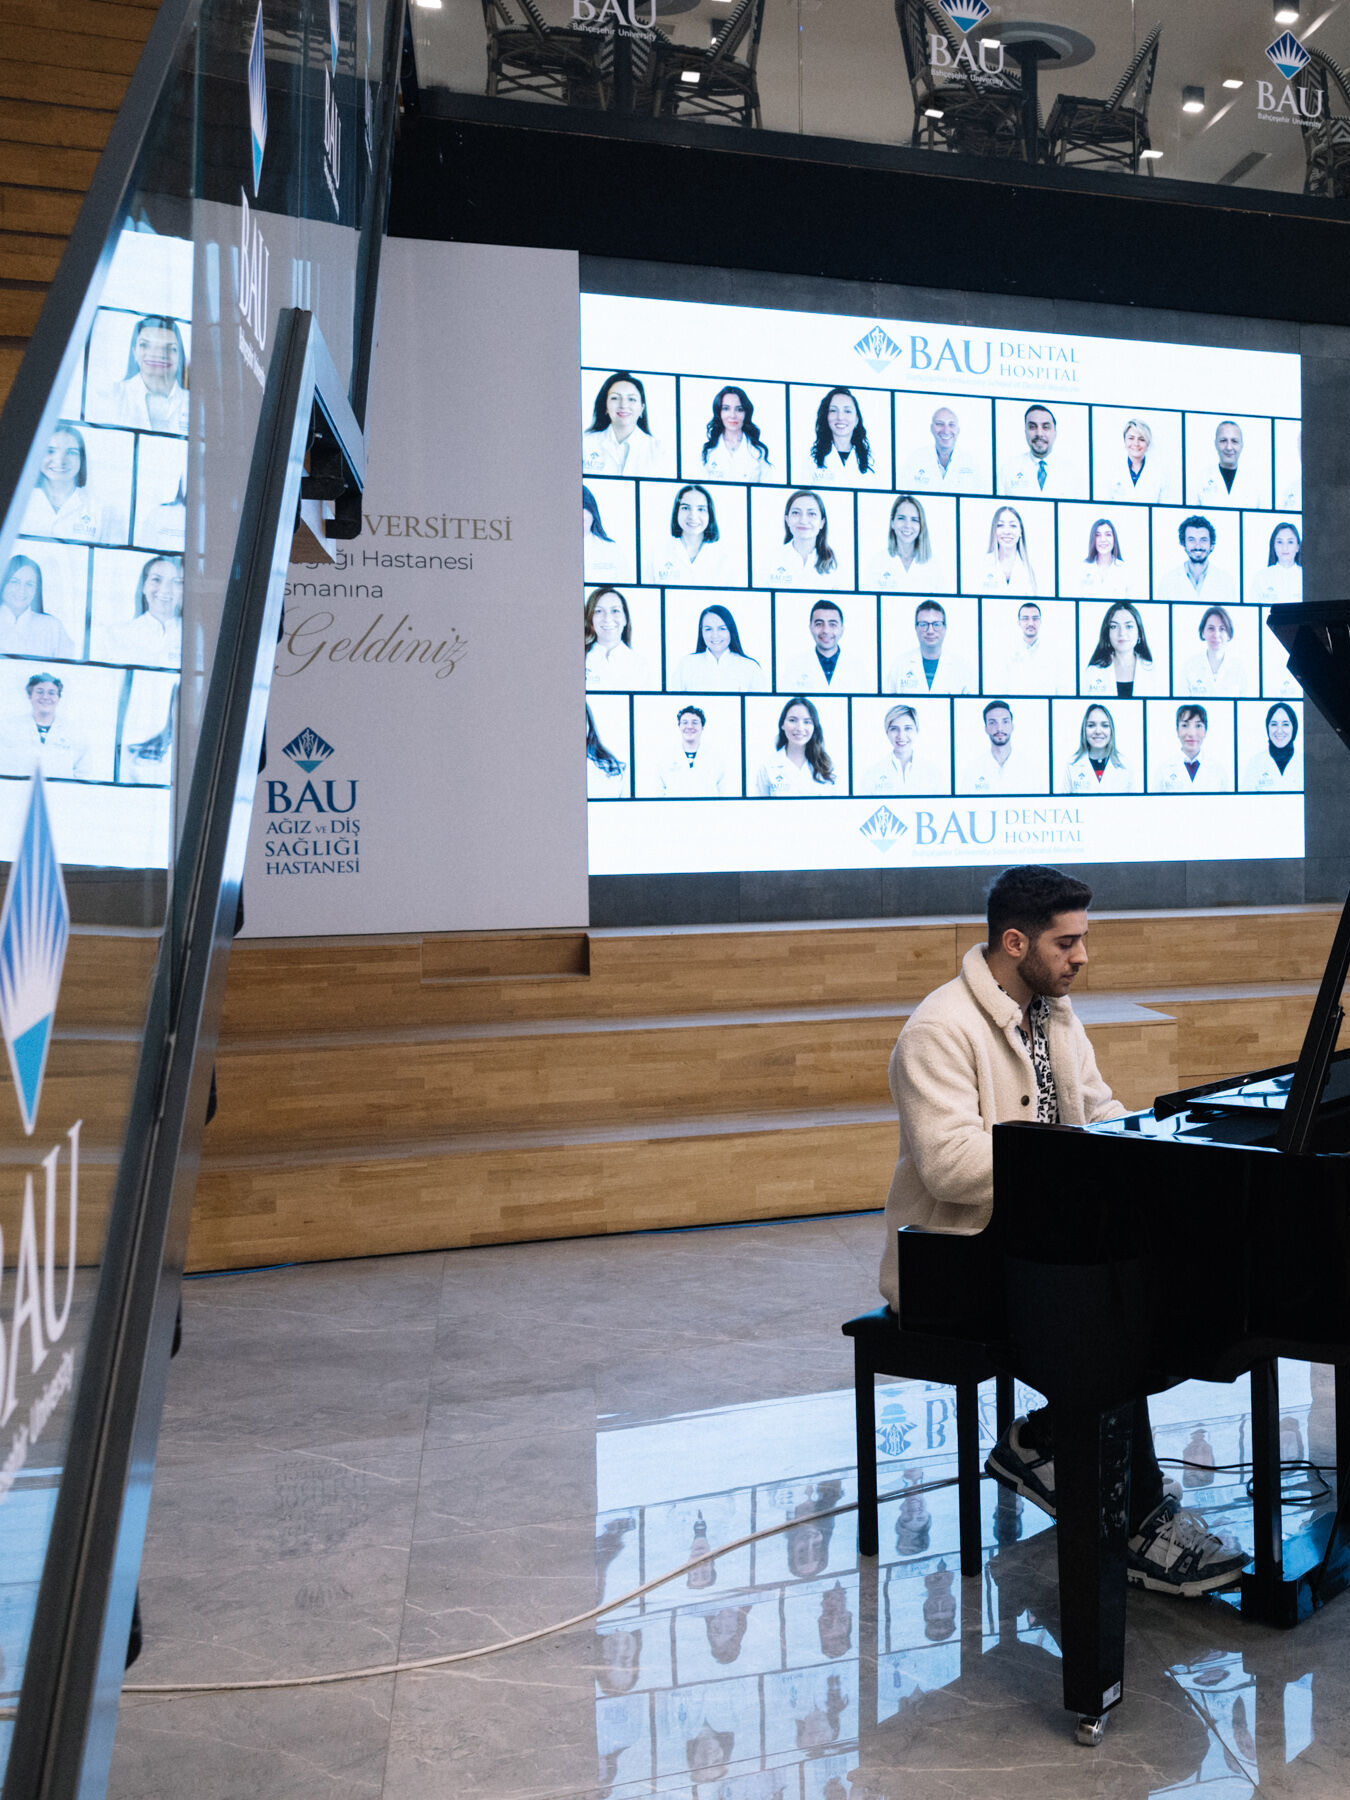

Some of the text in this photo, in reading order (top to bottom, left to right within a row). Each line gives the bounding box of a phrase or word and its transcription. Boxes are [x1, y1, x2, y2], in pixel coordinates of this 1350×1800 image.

[571, 0, 657, 29] BAU
[618, 29, 657, 42] University
[928, 33, 1007, 74] BAU
[1256, 80, 1325, 118] BAU
[238, 185, 270, 351] BAU
[909, 335, 1080, 374] BAU DENTAL
[1000, 363, 1080, 382] HOSPITAL
[362, 513, 513, 541] VERSİTESİ
[362, 550, 473, 570] Hastanesi
[284, 582, 383, 598] smanına
[274, 611, 468, 680] Geldiniz
[264, 779, 360, 814] BAU
[266, 817, 361, 838] AĞIZ VE DİŞ
[914, 808, 1084, 844] BAU DENTAL
[1005, 829, 1083, 844] HOSPITAL
[264, 837, 360, 857] SAĞLIĞI
[266, 858, 360, 876] HASTANESİ
[0, 1119, 83, 1430] AU
